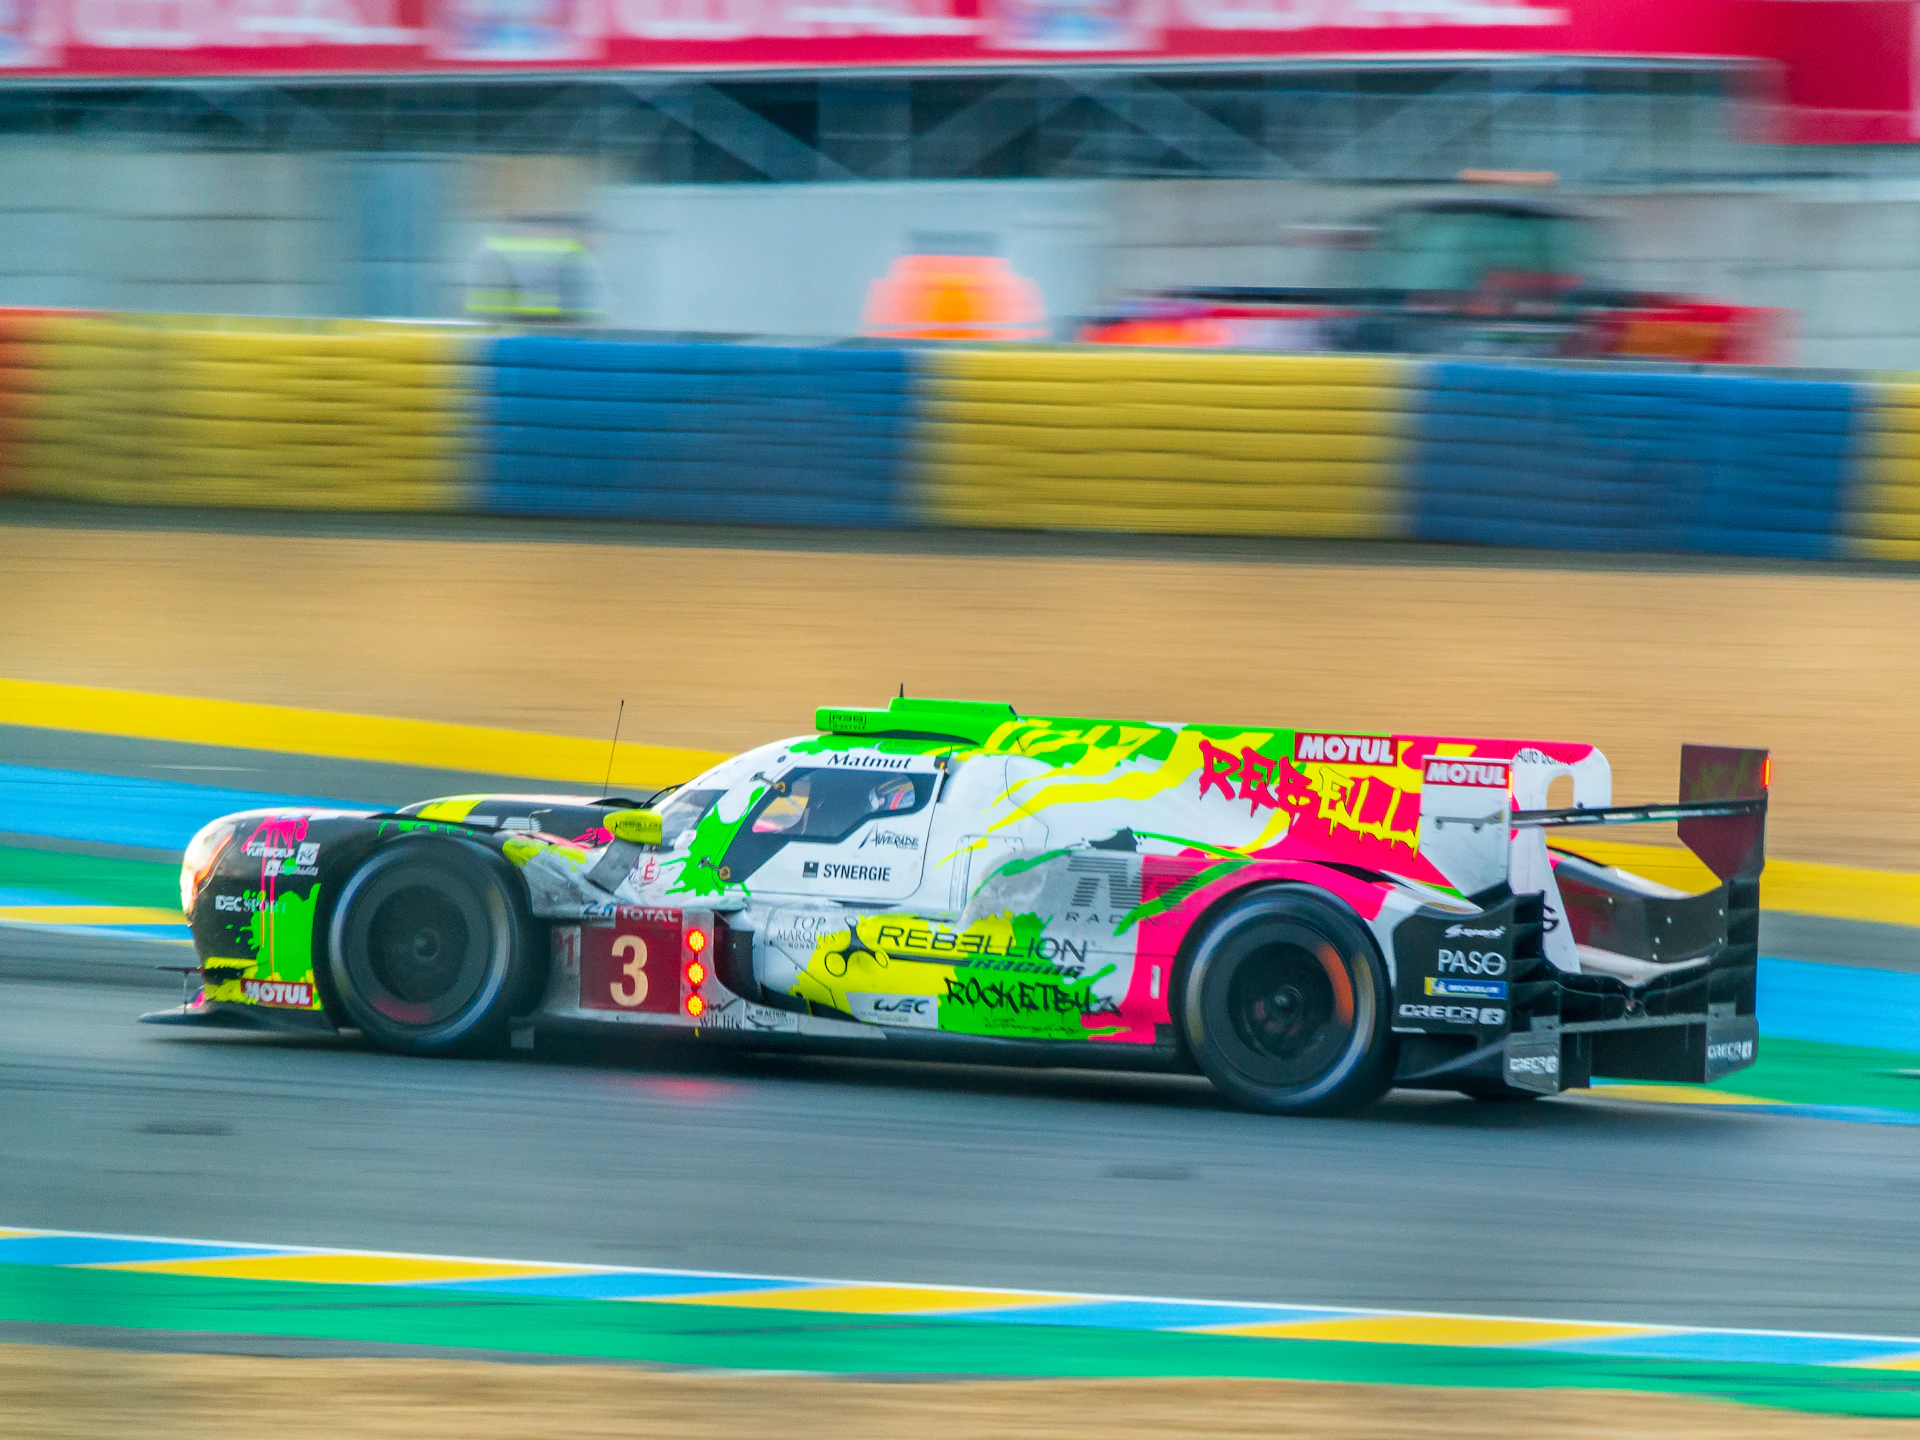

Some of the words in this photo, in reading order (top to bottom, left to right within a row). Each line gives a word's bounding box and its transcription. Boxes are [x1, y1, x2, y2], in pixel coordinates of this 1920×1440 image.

[1298, 735, 1394, 764] MOTUL
[827, 753, 912, 770] Matmut
[1425, 763, 1507, 785] MOTUL
[822, 863, 891, 882] SYNERGIE
[214, 895, 242, 912] IDEC
[620, 906, 679, 923] TOTAL
[793, 915, 827, 930] TOP
[877, 925, 1087, 963] REBELLION
[609, 934, 649, 1007] 3
[1438, 949, 1508, 976] PASO
[244, 982, 311, 1005] MOTUL
[873, 998, 930, 1014] WEC
